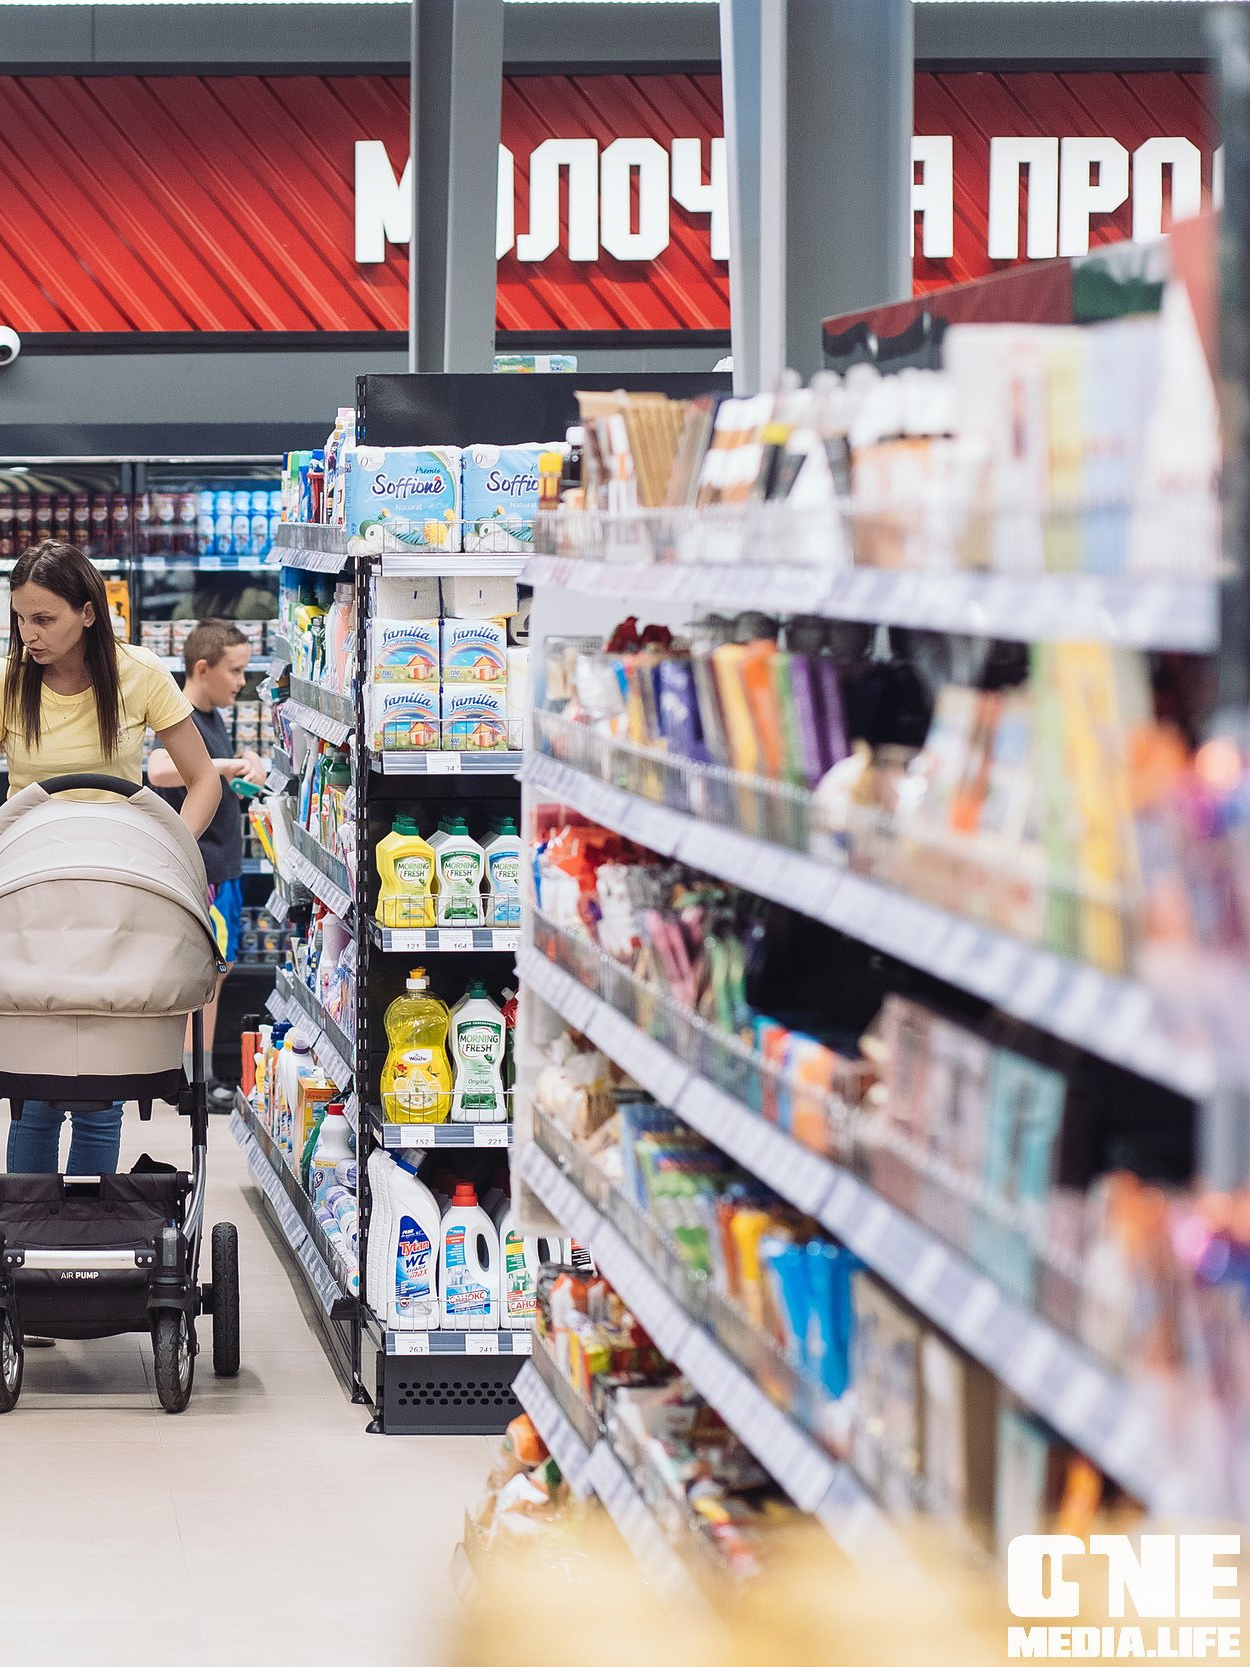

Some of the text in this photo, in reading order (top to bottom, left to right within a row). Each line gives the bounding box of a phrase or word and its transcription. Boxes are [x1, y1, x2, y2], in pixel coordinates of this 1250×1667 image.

[988, 137, 1224, 259] ПРО
[372, 473, 445, 498] Soffione
[487, 471, 540, 496] Soffio
[395, 503, 422, 511] Natural
[382, 625, 430, 645] familia
[452, 625, 500, 646] familia
[383, 691, 431, 712] familia
[450, 692, 498, 713] familia
[398, 862, 429, 870] MORNING
[444, 861, 477, 869] MORNING
[459, 1034, 499, 1043] MORNING
[465, 1044, 492, 1052] FRESH
[468, 1078, 490, 1086] Original
[400, 1240, 429, 1256] Tytan
[406, 1252, 429, 1268] WC
[61, 1271, 99, 1279] AIR PUMP
[510, 1301, 536, 1310] САНО
